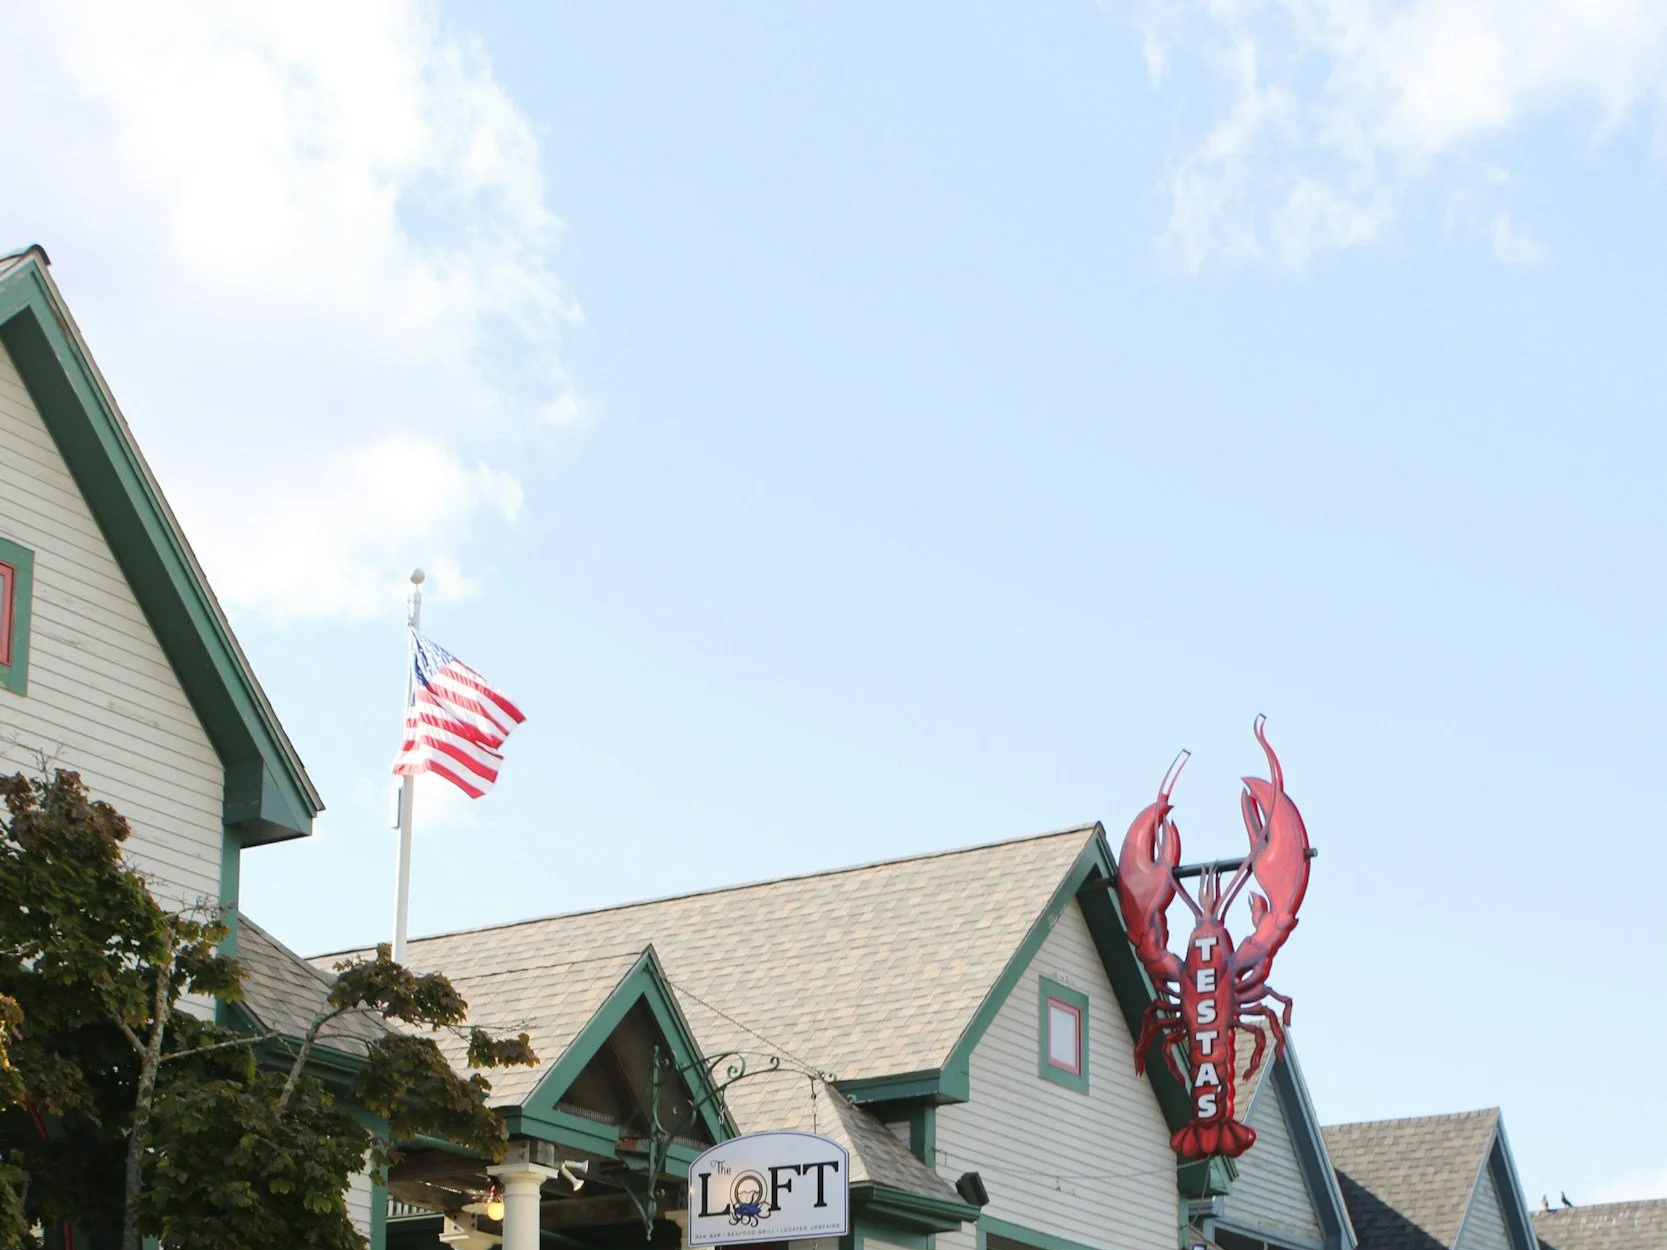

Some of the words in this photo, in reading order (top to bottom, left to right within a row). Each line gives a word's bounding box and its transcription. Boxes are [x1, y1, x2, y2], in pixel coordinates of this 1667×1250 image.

[1195, 936, 1221, 1119] TESTA'S
[710, 1159, 732, 1175] The
[698, 1161, 839, 1218] LOFT
[809, 1222, 841, 1231] UPSTAIRS
